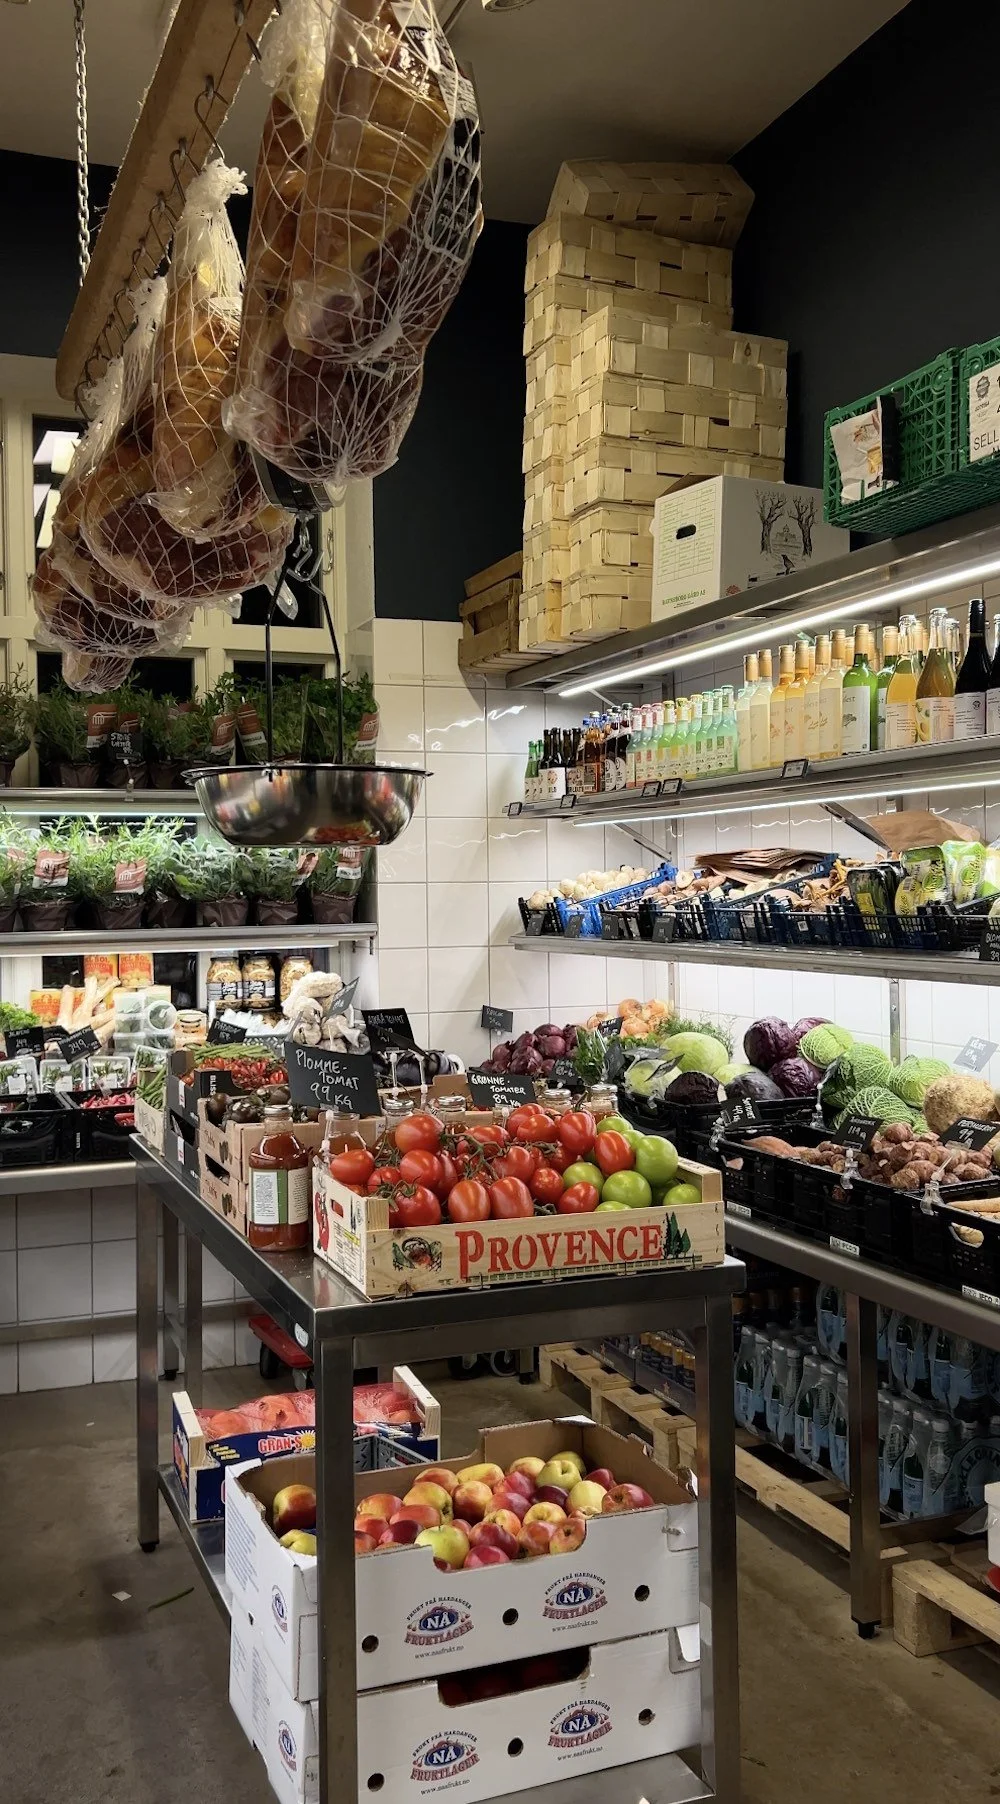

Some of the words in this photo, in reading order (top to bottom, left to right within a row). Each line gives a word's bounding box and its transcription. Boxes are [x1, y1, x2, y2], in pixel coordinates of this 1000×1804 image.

[310, 1082, 331, 1102] 99
[319, 1071, 359, 1090] TOMAT
[490, 1085, 526, 1095] TOMATER
[493, 1093, 507, 1104] 89
[455, 1224, 663, 1280] PROVENCE
[545, 1579, 561, 1595] FRUKT
[575, 1572, 606, 1585] HARDANGER
[563, 1588, 587, 1603] NÅ
[407, 1604, 424, 1620] FRUKT
[438, 1597, 472, 1609] HARDANGER
[542, 1596, 608, 1619] FRUKTLAGER
[427, 1612, 451, 1629] NÅ
[404, 1621, 474, 1646] FRUKTLAGER
[550, 1708, 566, 1724] FRUKT
[580, 1700, 610, 1711] HARDANGER
[569, 1715, 591, 1731] NÅ
[412, 1739, 430, 1757] FRUKT
[444, 1730, 477, 1742] HARDANGER
[548, 1722, 613, 1748] FRUKTLAGER
[433, 1746, 457, 1764] NÅ
[410, 1753, 480, 1781] FRUKTLAGER
